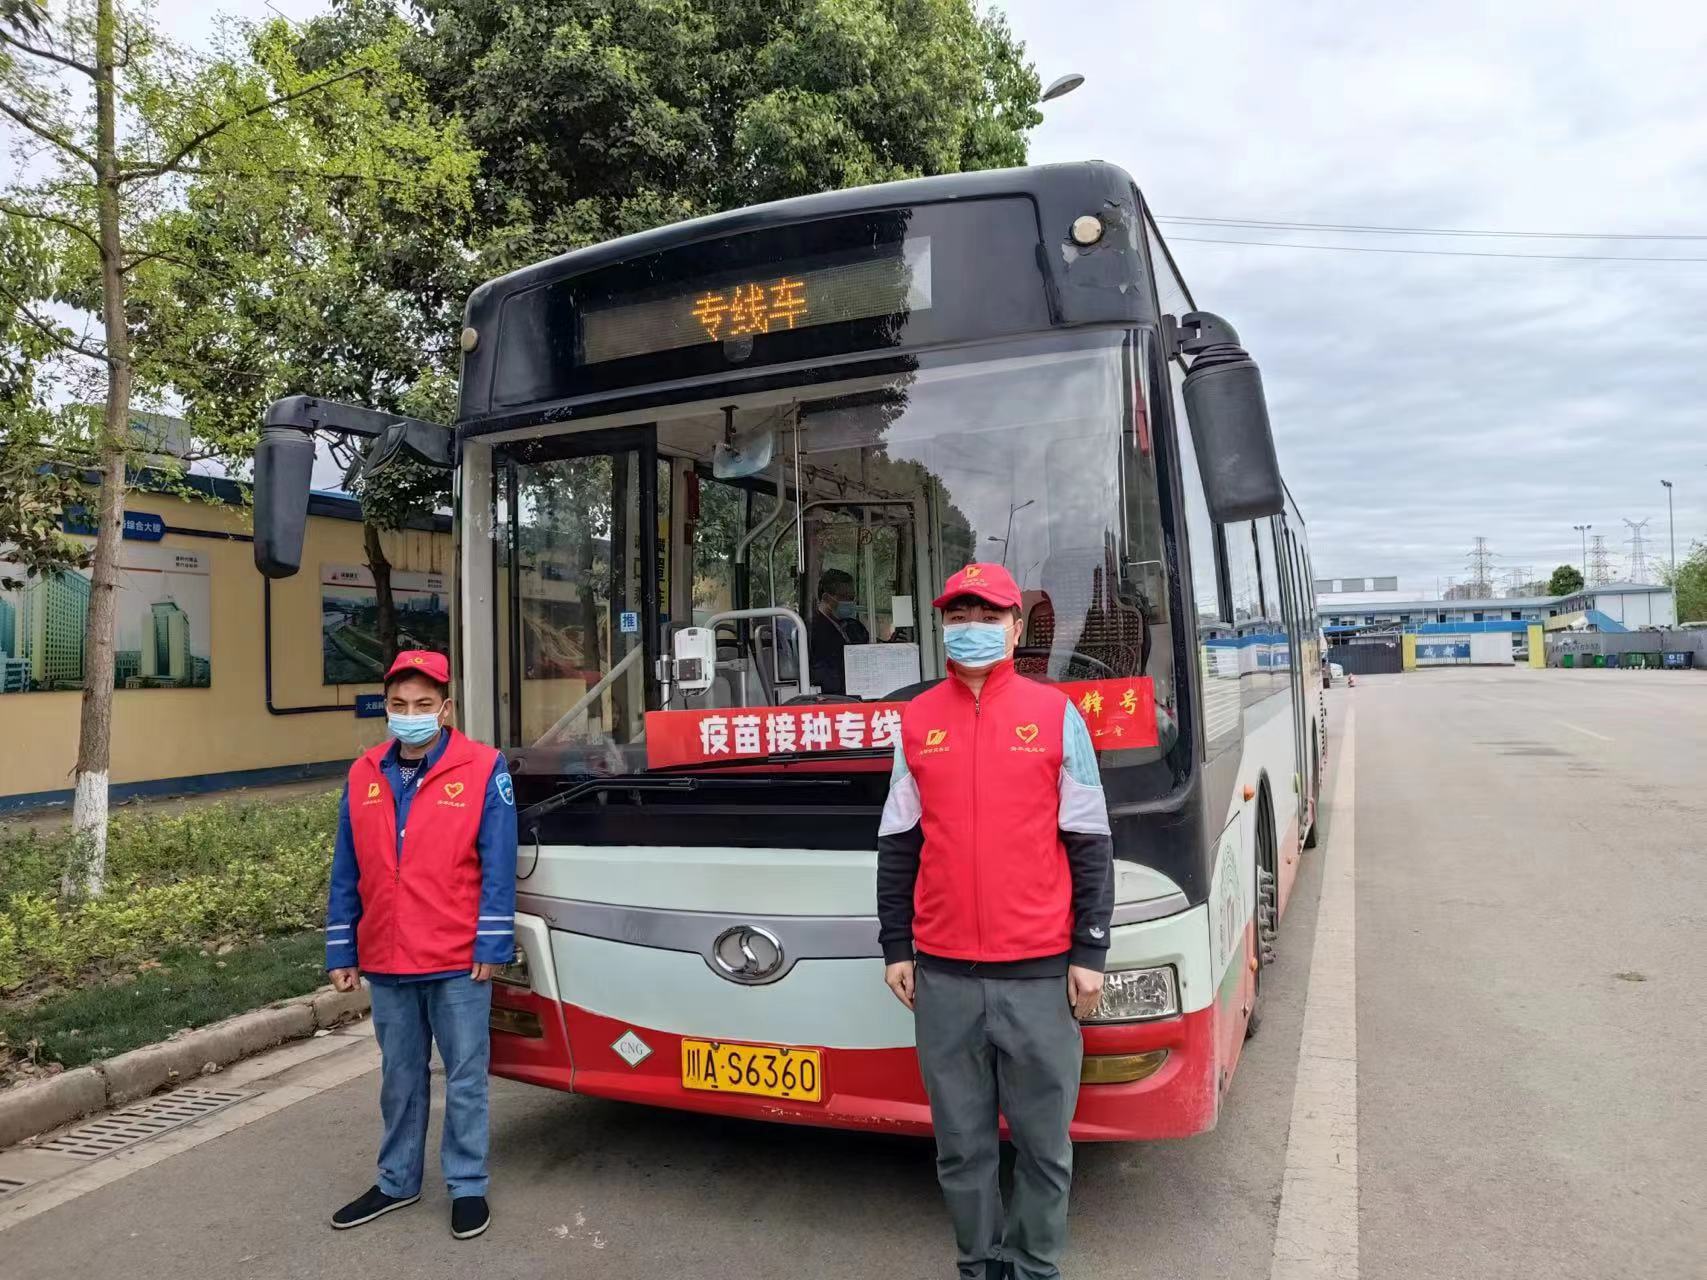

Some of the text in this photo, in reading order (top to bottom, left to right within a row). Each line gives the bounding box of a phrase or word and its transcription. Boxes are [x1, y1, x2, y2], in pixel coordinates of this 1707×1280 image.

[691, 278, 808, 341] 专线车
[622, 613, 635, 628] 推
[698, 709, 902, 755] 疫苗接种专线
[619, 1041, 643, 1056] CNG
